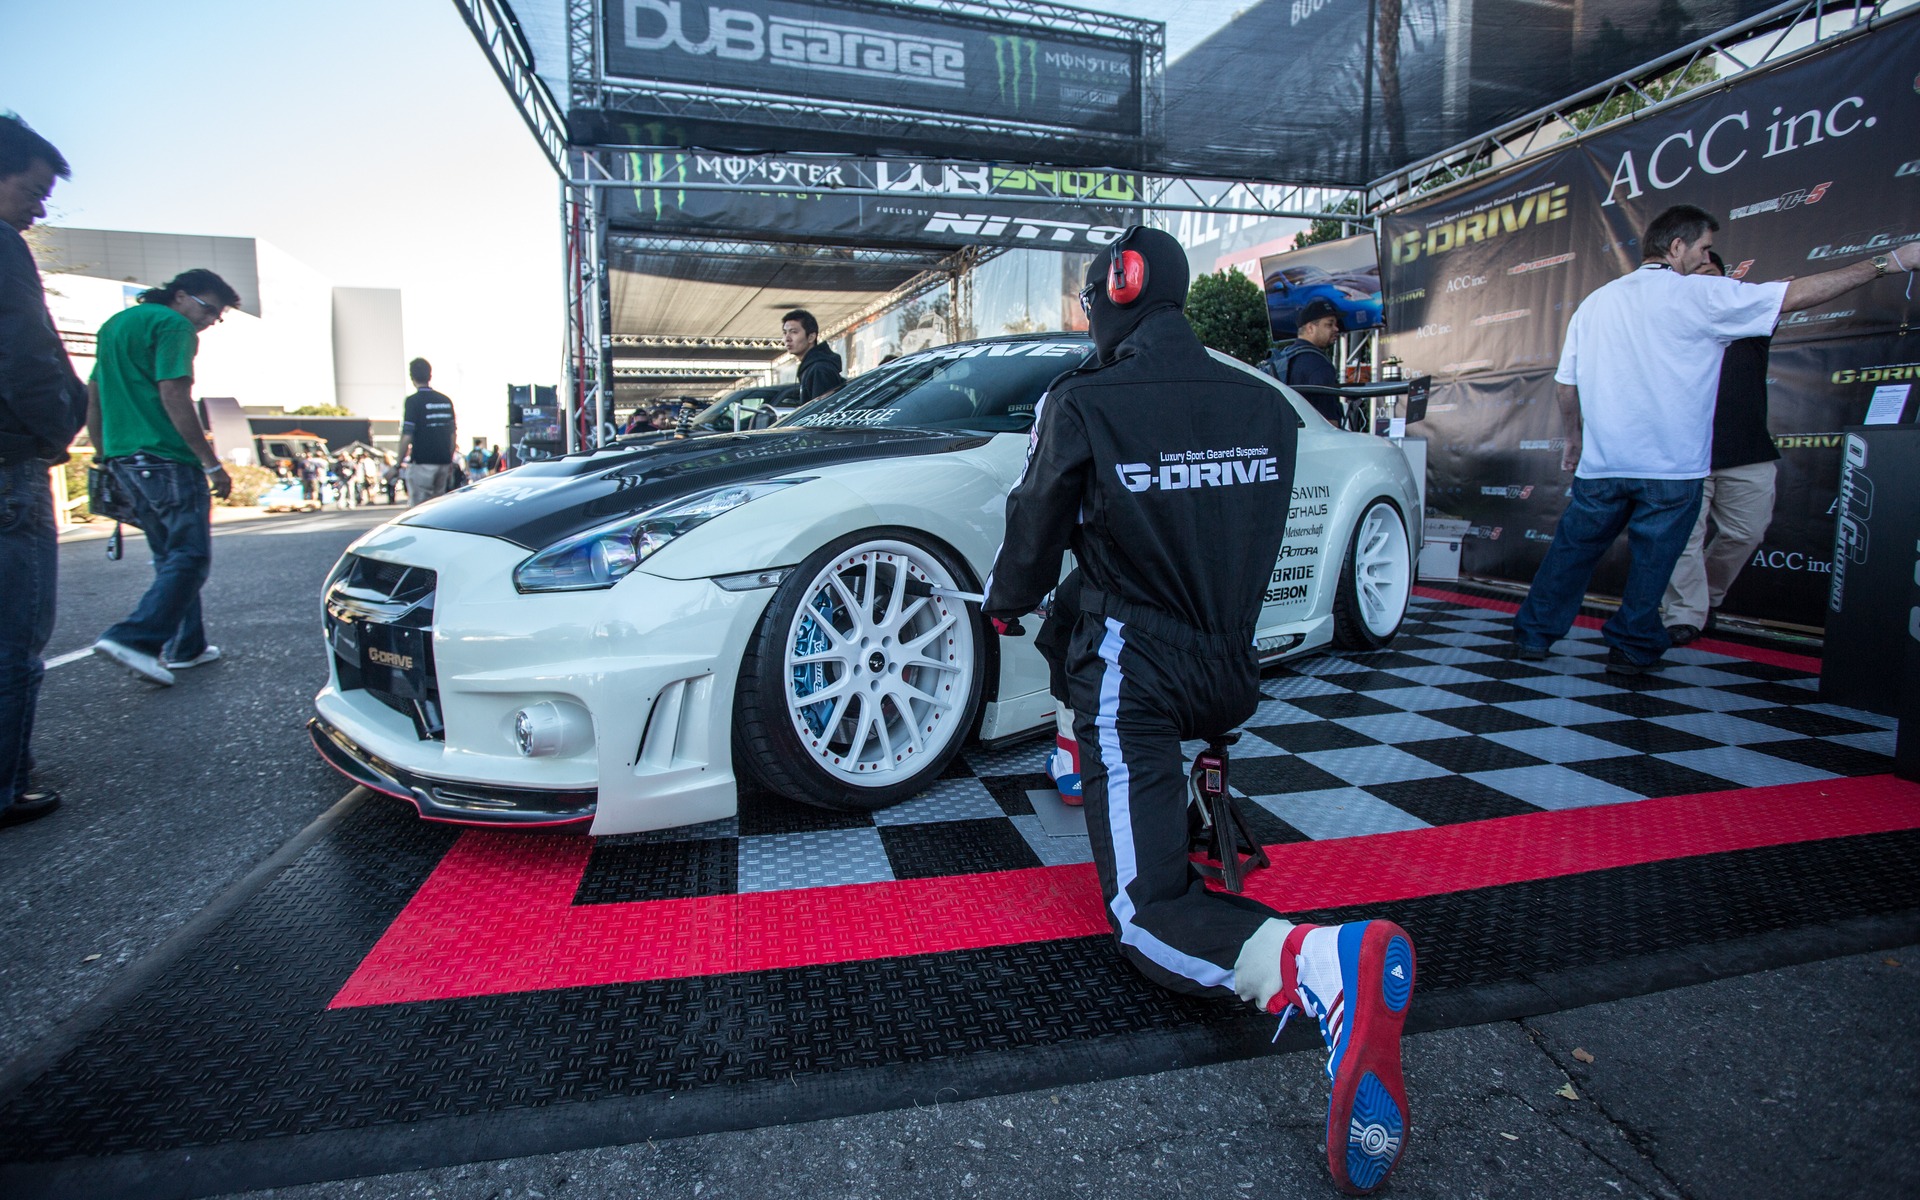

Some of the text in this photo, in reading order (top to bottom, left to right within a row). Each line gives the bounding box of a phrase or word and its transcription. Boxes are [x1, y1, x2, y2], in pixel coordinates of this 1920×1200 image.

[624, 0, 765, 61] DUB
[1045, 51, 1131, 77] MONSTER
[1601, 96, 1877, 207] ACC inc.
[696, 155, 845, 186] MONSTER
[876, 162, 1134, 201] DUB SHOW
[877, 206, 913, 215] FUELED
[924, 211, 1126, 245] NITTO
[1445, 275, 1471, 293] ACC
[1416, 323, 1438, 339] ACC
[523, 408, 541, 416] DUB
[1008, 403, 1034, 412] BRID
[1160, 450, 1185, 462] Luxury
[1186, 450, 1205, 462] Sport
[1206, 447, 1235, 459] Geared
[1116, 457, 1279, 492] G-DRIVE
[1291, 486, 1330, 500] SAVINI
[1284, 523, 1323, 539] Meisterschaft
[1279, 545, 1318, 561] ROTORA
[1751, 550, 1804, 569] ACC
[1273, 565, 1314, 582] BRIDE
[1264, 585, 1308, 602] SEBON
